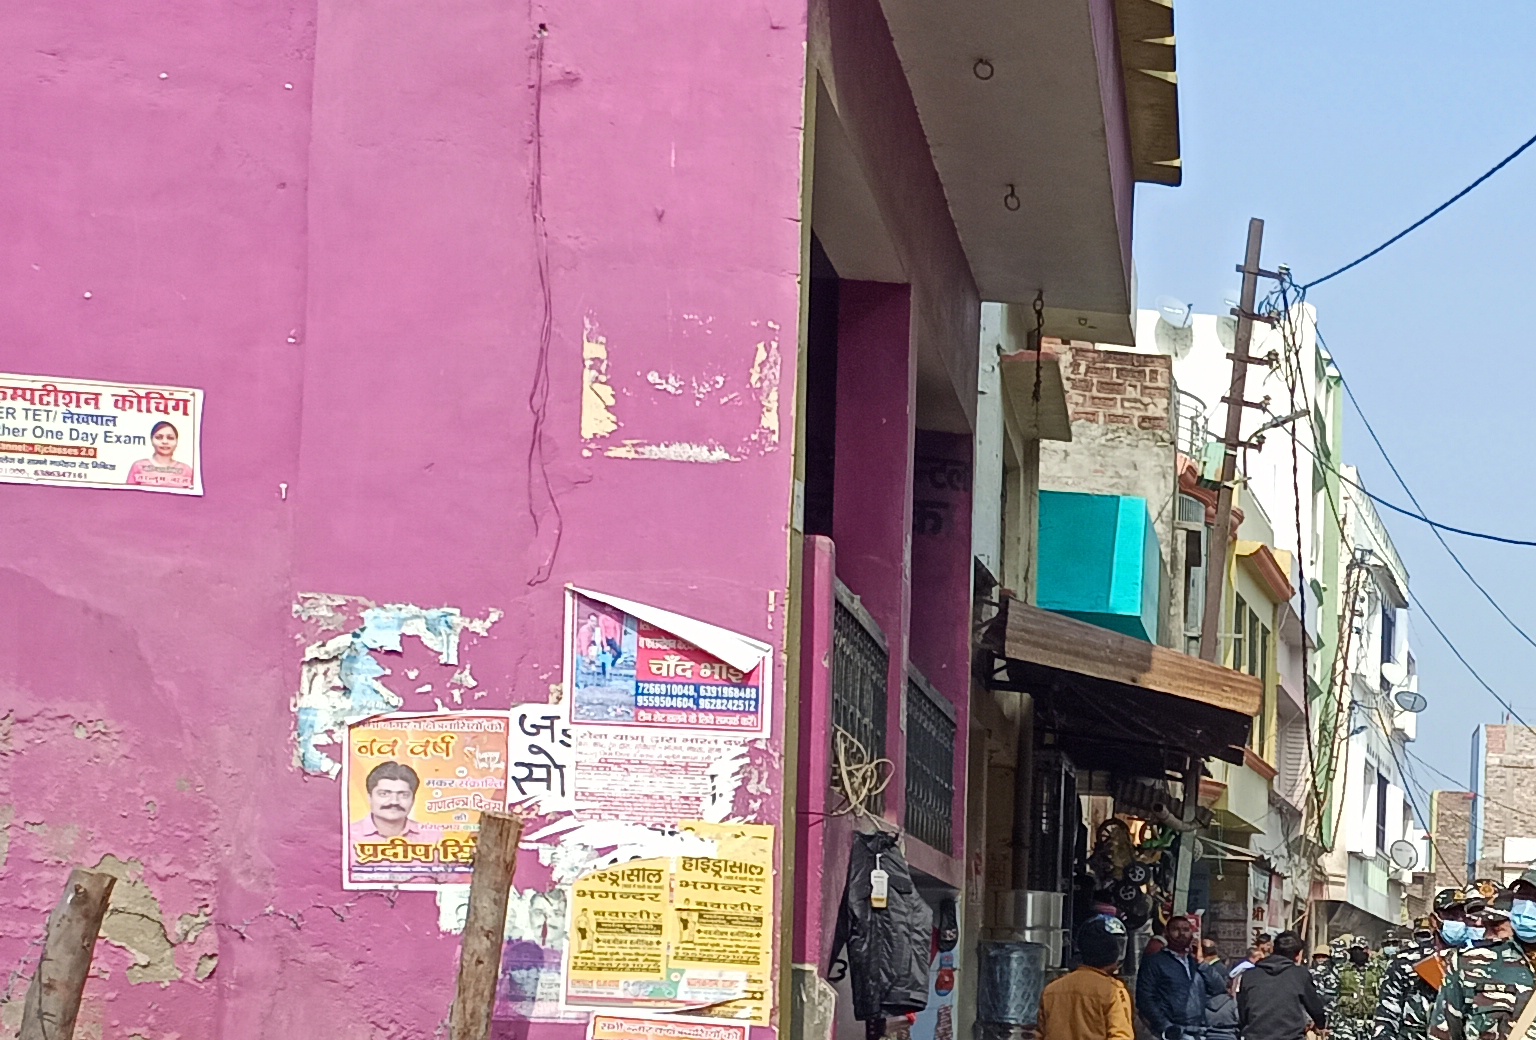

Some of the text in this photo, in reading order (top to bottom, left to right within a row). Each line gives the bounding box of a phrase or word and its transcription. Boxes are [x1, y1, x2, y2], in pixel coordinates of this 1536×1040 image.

[111, 390, 191, 417] कोचिंग
[61, 409, 118, 427] लेखपाल
[33, 426, 64, 441] One
[69, 428, 99, 446] Day
[104, 430, 147, 447] Exam
[357, 738, 398, 757] नव
[409, 735, 456, 758] वर्ष
[355, 838, 433, 863] प्रदीप
